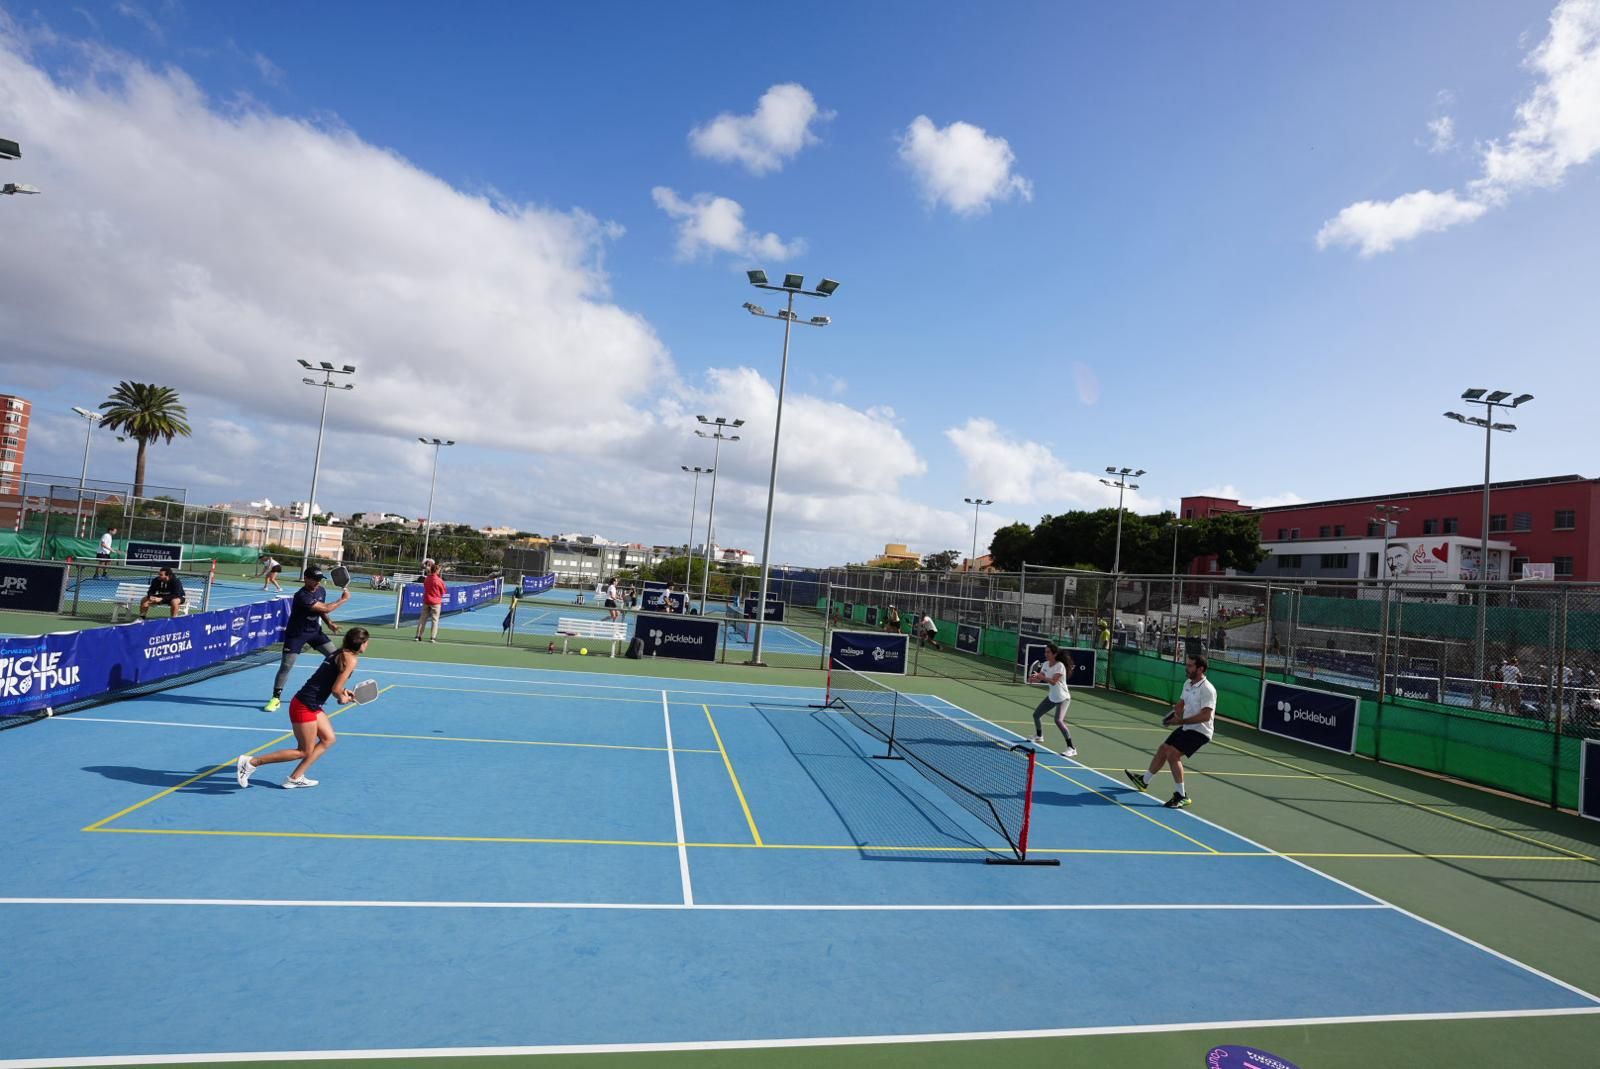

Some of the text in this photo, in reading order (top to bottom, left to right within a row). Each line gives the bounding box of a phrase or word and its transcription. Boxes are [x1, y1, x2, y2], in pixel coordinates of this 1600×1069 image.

[134, 552, 172, 560] VICTORIA
[149, 630, 190, 646] CERVEZAS
[664, 633, 703, 645] picklebull
[144, 639, 192, 659] VICTORIA
[1293, 708, 1336, 727] picklebull
